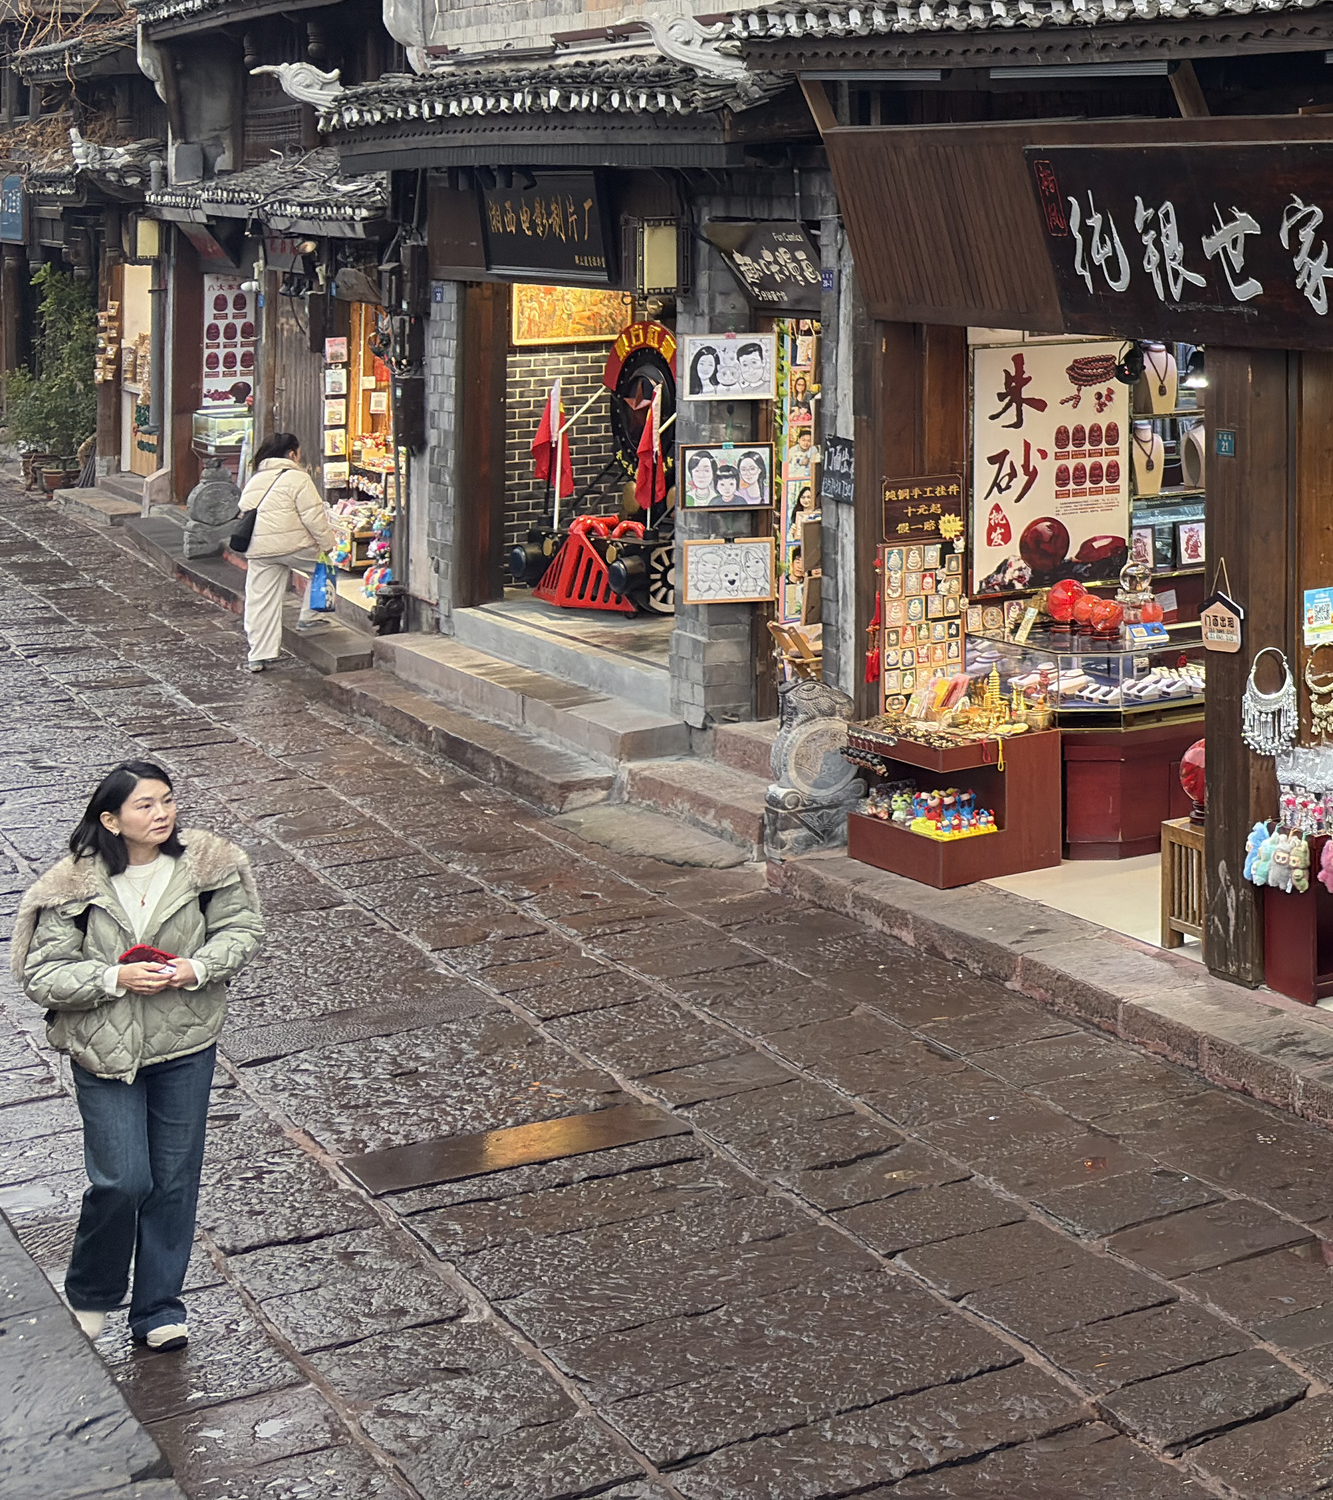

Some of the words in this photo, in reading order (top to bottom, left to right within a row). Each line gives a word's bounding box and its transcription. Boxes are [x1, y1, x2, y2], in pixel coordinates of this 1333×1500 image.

[983, 353, 1048, 504] 朱砂
[903, 503, 942, 517] 十元起
[988, 509, 1007, 547] 批发
